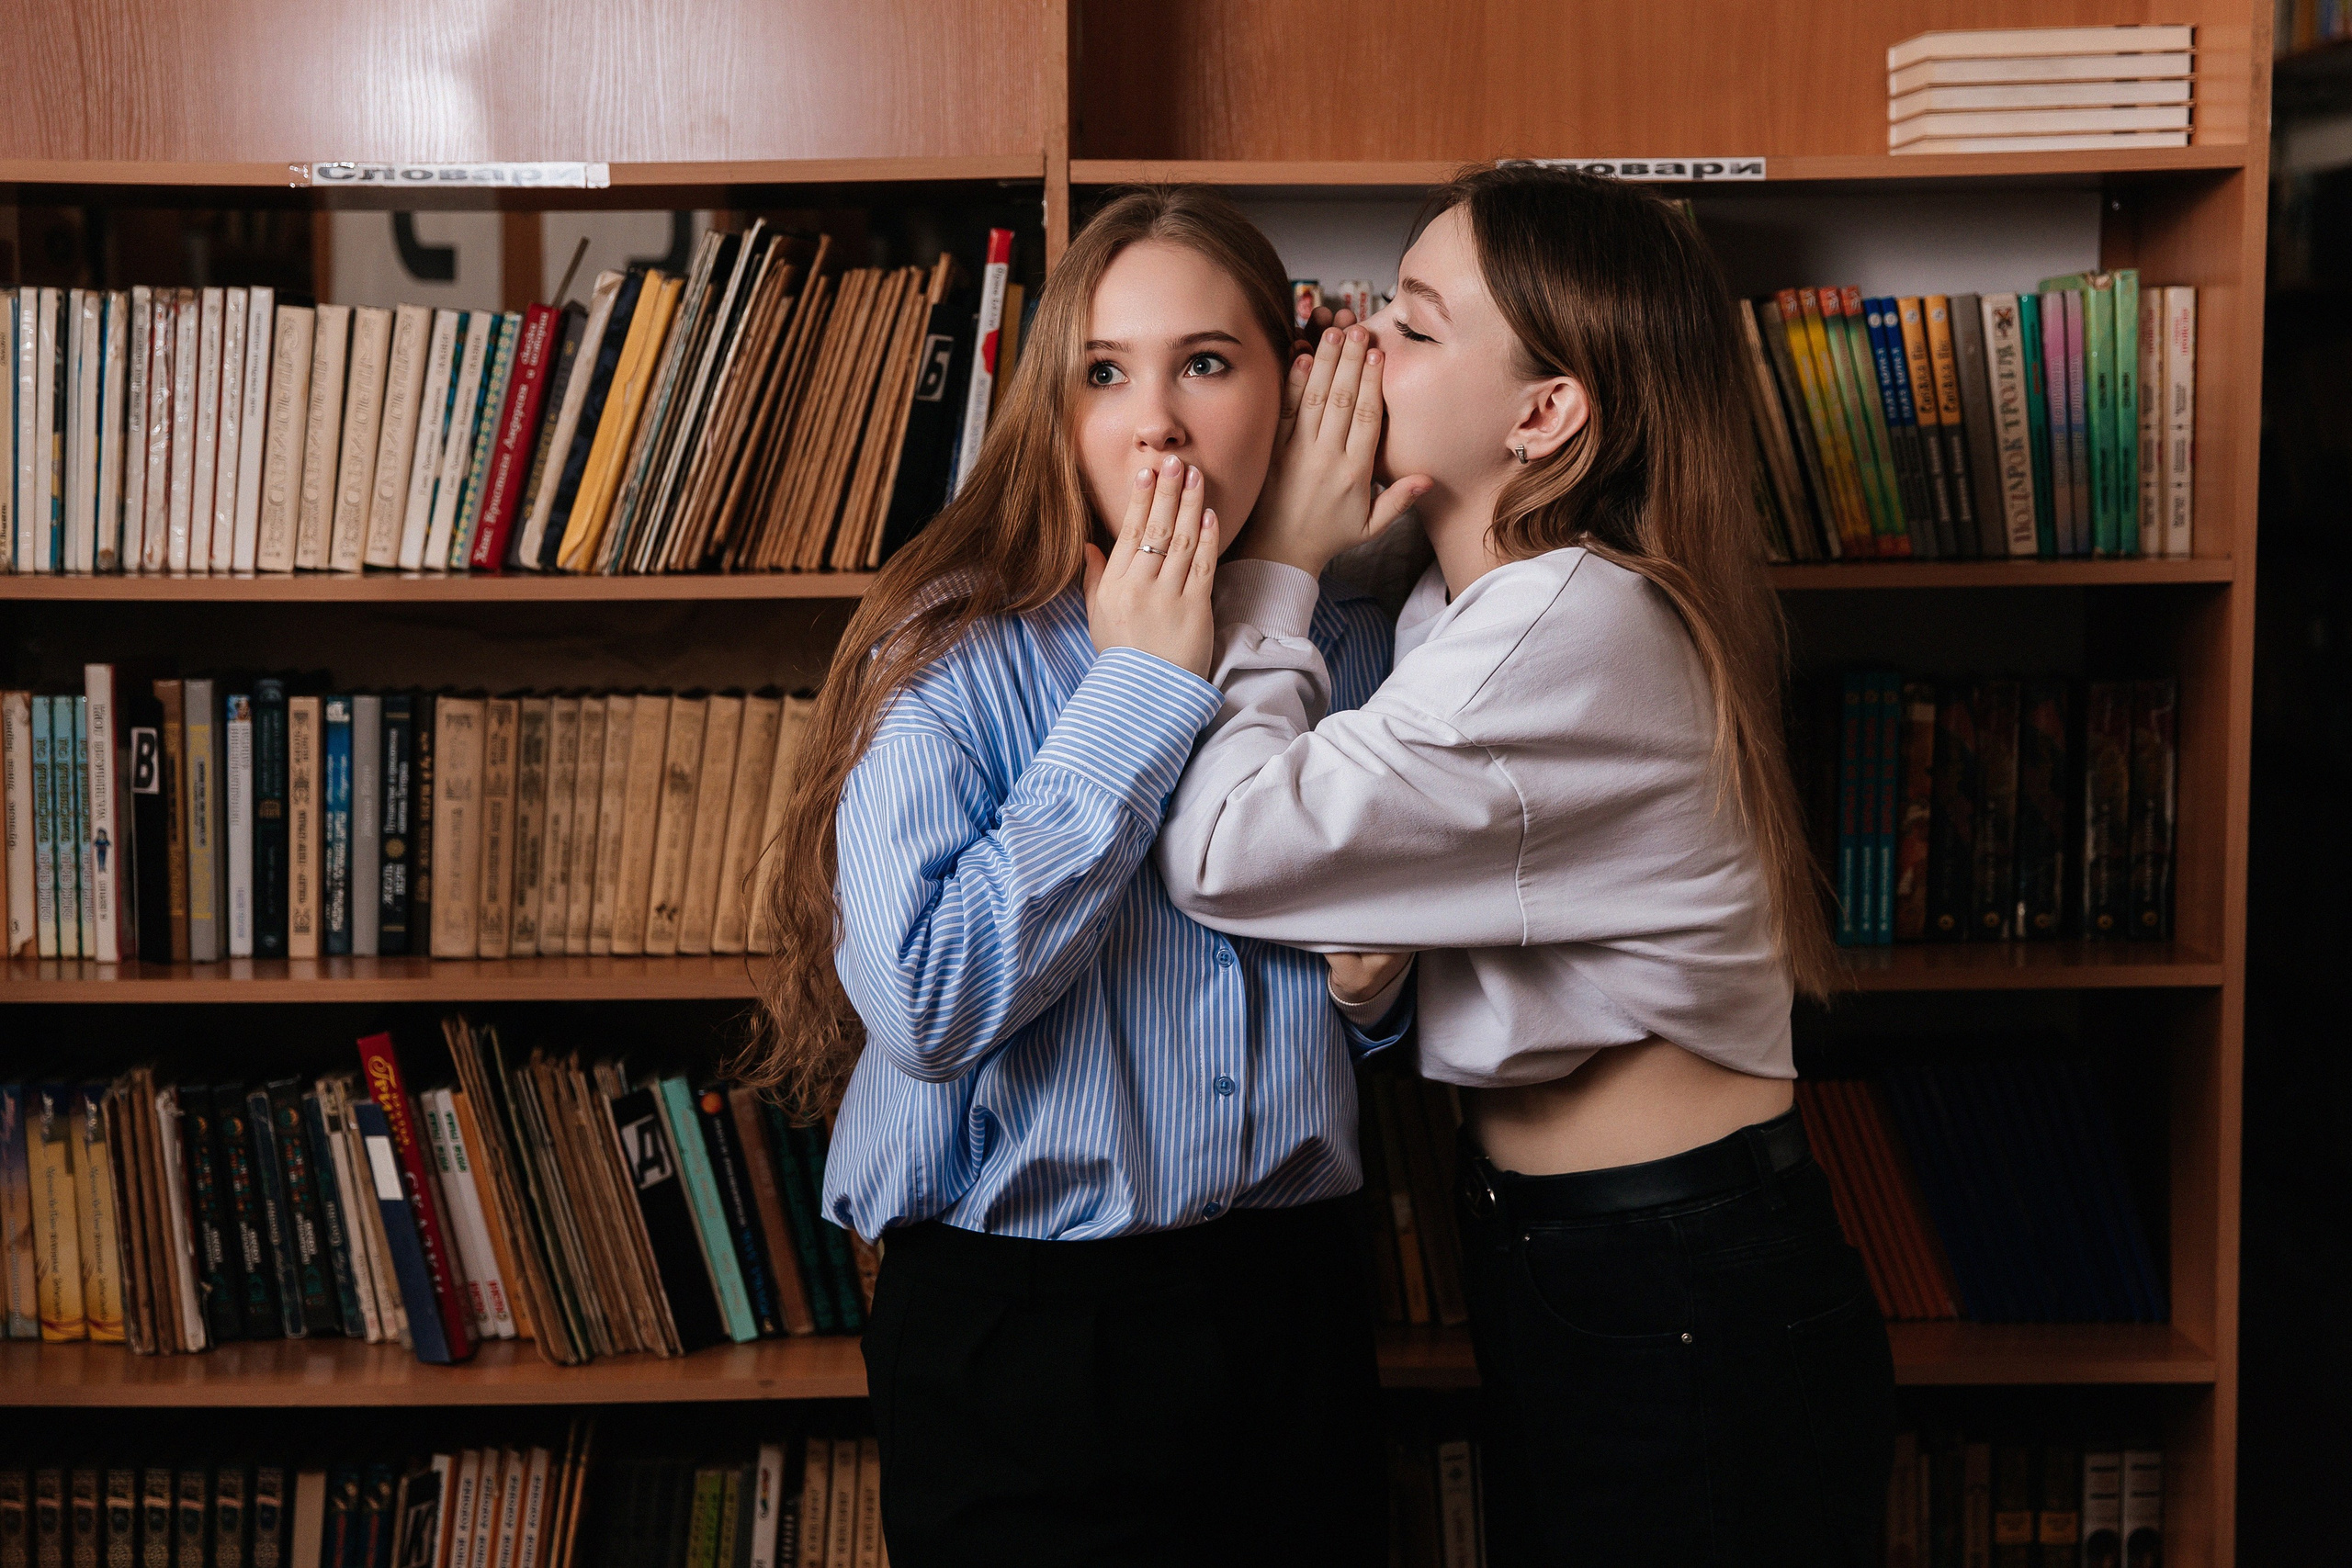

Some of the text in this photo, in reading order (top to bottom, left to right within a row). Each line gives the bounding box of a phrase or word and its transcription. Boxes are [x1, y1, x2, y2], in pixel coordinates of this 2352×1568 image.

[502, 381, 532, 451] Андерсен
[2004, 435, 2031, 545] ПОДАРОК
[135, 732, 156, 788] В
